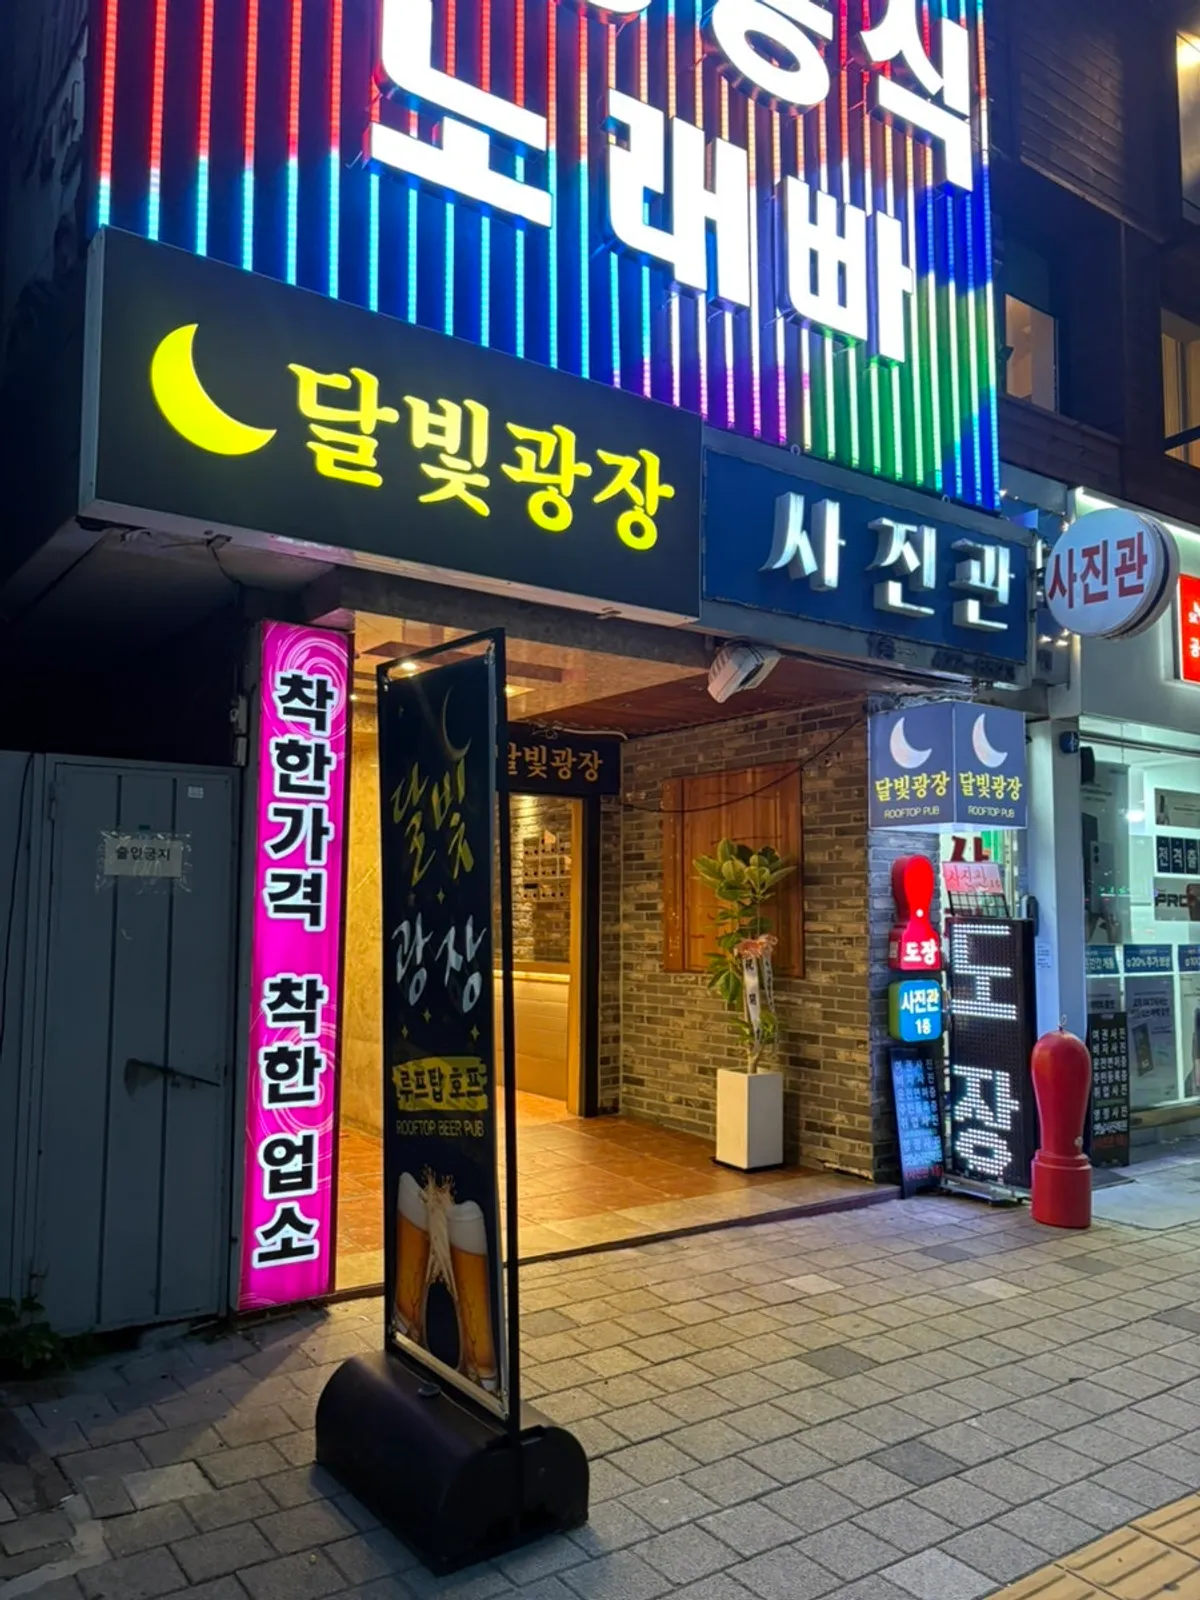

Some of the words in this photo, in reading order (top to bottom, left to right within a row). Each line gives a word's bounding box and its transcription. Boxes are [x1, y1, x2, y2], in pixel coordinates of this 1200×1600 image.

[287, 362, 676, 551] 달빛광장
[758, 491, 1015, 632] 사진관
[1048, 530, 1148, 610] 사진관
[874, 770, 951, 802] 달빛광장
[959, 770, 1023, 801] 달빛광장
[884, 807, 922, 819] ROOFTOP
[922, 805, 940, 816] PUB
[967, 804, 1001, 814] ROOFTOP
[1001, 807, 1016, 819] PUB
[391, 912, 488, 1014] 광장
[903, 938, 939, 965] 도장
[900, 988, 940, 1014] 사진관
[914, 1017, 932, 1035] 1층
[950, 923, 1021, 1177] 도장
[398, 1066, 445, 1103] 루프탑
[449, 1066, 484, 1099] 호프
[396, 1119, 437, 1136] ROOFTOP
[438, 1119, 463, 1137] BEER
[463, 1119, 486, 1138] PUB
